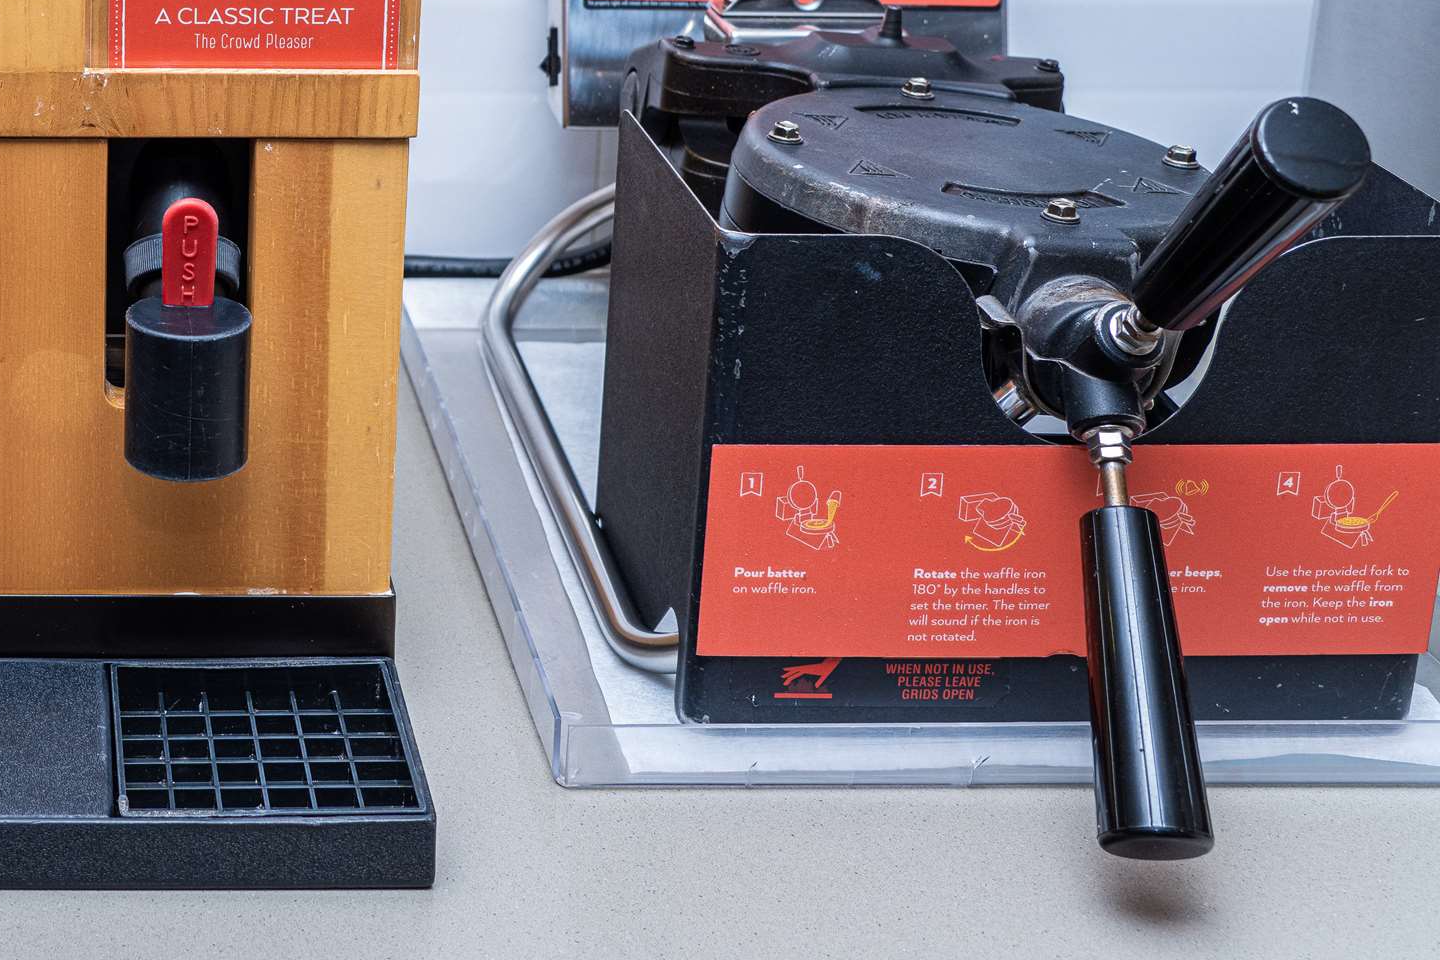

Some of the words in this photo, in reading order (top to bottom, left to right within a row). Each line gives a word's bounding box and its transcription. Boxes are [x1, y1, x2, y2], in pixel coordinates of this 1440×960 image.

[155, 7, 171, 25] A
[177, 7, 274, 25] CLASSIC
[280, 7, 355, 25] TREAT
[194, 33, 216, 50] The
[221, 33, 260, 50] Crowd
[266, 33, 314, 50] Pleaser
[181, 215, 198, 304] PUSH
[927, 478, 937, 489] 2
[1283, 477, 1294, 488] 4
[734, 568, 765, 578] Pour
[768, 568, 806, 578] batter
[914, 568, 957, 579] Rotate
[961, 568, 979, 579] the
[983, 568, 1021, 579] waffle
[1024, 568, 1046, 579] iron
[1185, 565, 1222, 580] beeps.
[1266, 566, 1289, 577] Use
[1293, 566, 1311, 577] the
[1315, 565, 1366, 580] provided
[1370, 565, 1394, 577] fork
[1397, 567, 1409, 577] to
[733, 585, 748, 594] on
[751, 583, 789, 594] waffle
[792, 583, 817, 594] iron.
[912, 583, 941, 595] 180°
[944, 584, 959, 598] by
[962, 584, 981, 595] the
[985, 584, 1030, 595] handles
[1033, 585, 1046, 595] to
[1181, 583, 1206, 593] iron.
[1263, 583, 1308, 593] remove
[1312, 581, 1330, 593] the
[1334, 581, 1371, 593] waffle
[1374, 581, 1403, 592] from
[910, 601, 929, 611] set
[933, 599, 951, 611] the
[955, 600, 989, 611] timer.
[993, 600, 1015, 611] The
[1019, 600, 1050, 611] timer
[1261, 598, 1280, 609] the
[1284, 598, 1309, 609] iron.
[1313, 598, 1343, 611] Keep
[1347, 597, 1366, 608] the
[1369, 598, 1393, 608] iron
[909, 615, 928, 627] will
[931, 615, 967, 627] sound
[971, 615, 979, 627] if
[982, 615, 1002, 627] the
[1005, 615, 1027, 627] iron
[1031, 615, 1040, 627] is
[1259, 616, 1288, 626] open
[1291, 613, 1321, 624] while
[1324, 613, 1344, 624] not
[1347, 613, 1358, 624] in
[1361, 615, 1384, 624] use.
[908, 632, 927, 642] not
[931, 631, 977, 642] rotated.
[886, 664, 922, 675] WHEN
[924, 664, 950, 675] NOT
[953, 664, 965, 675] IN
[898, 676, 941, 688] PLEASE
[944, 676, 981, 688] LEAVE
[902, 689, 939, 700] GRIDS
[942, 689, 975, 701] OPEN
